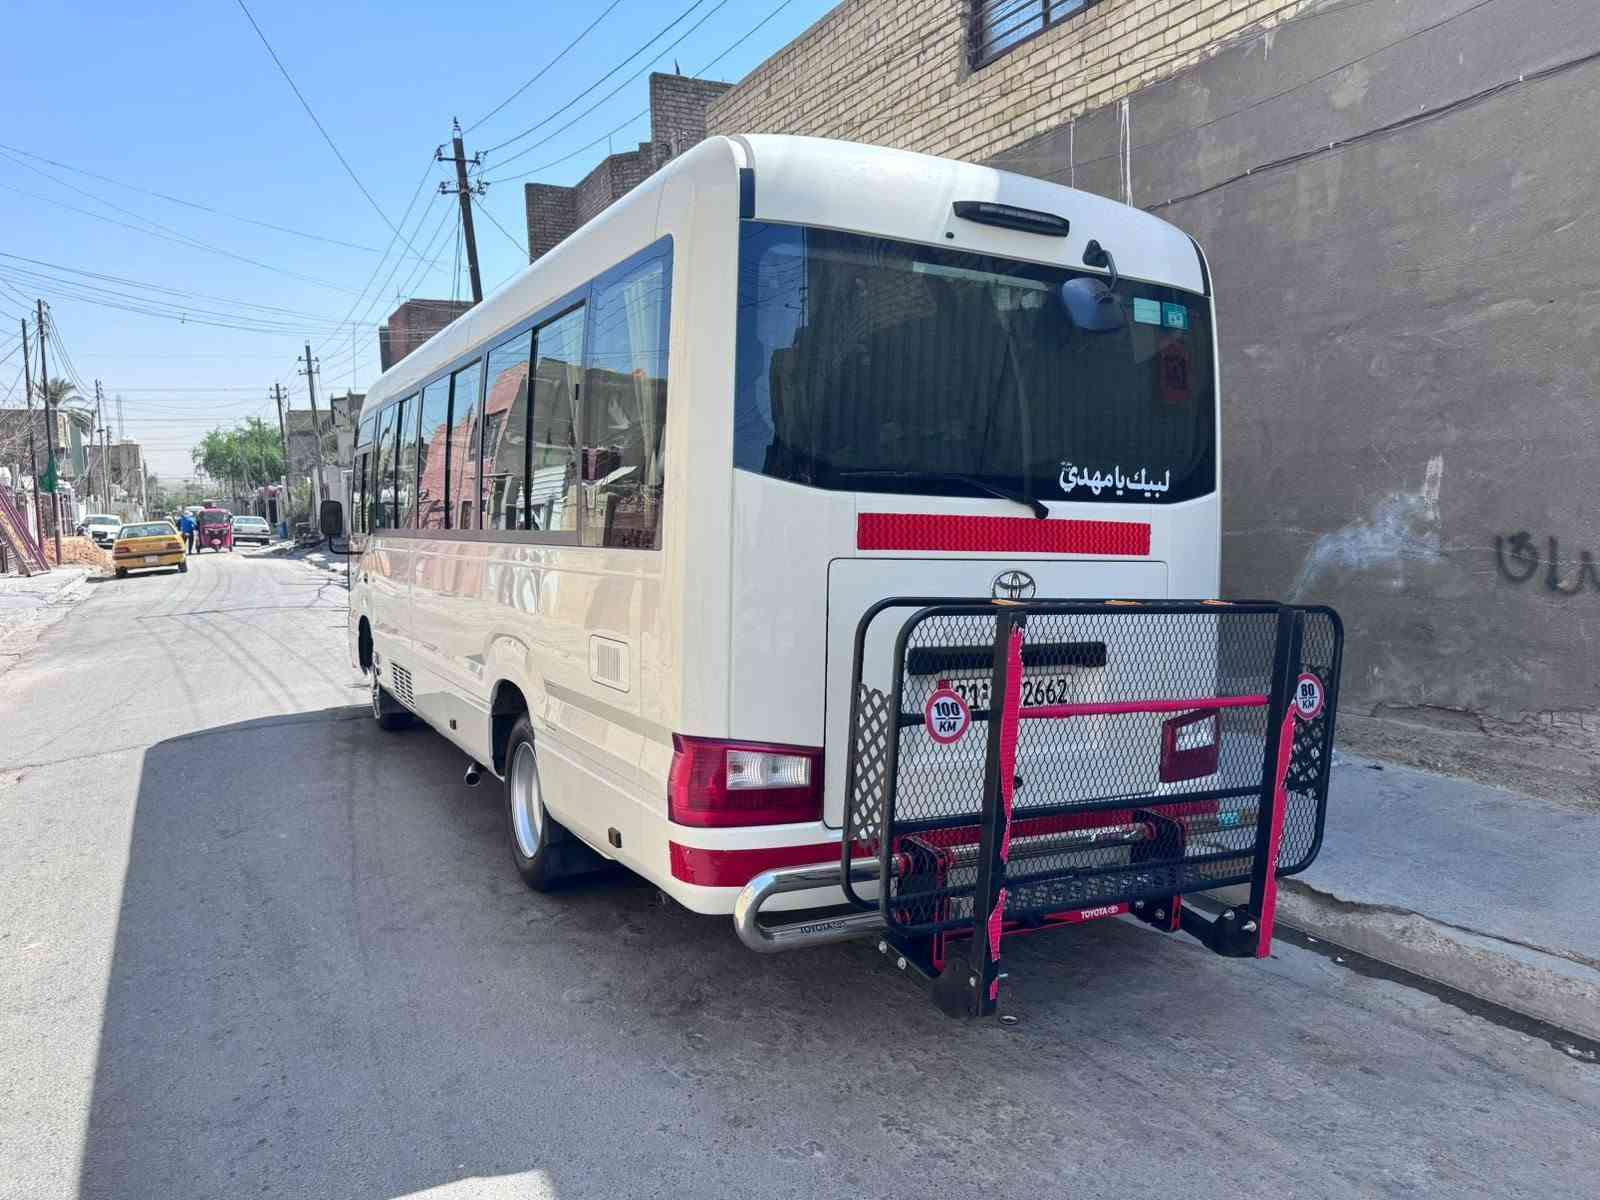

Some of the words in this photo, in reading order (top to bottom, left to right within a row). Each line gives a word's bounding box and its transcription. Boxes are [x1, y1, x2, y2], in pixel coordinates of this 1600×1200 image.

[1301, 683, 1315, 697] 80
[934, 701, 960, 717] 100
[939, 720, 957, 732] KM
[1080, 906, 1107, 920] TOYOTA
